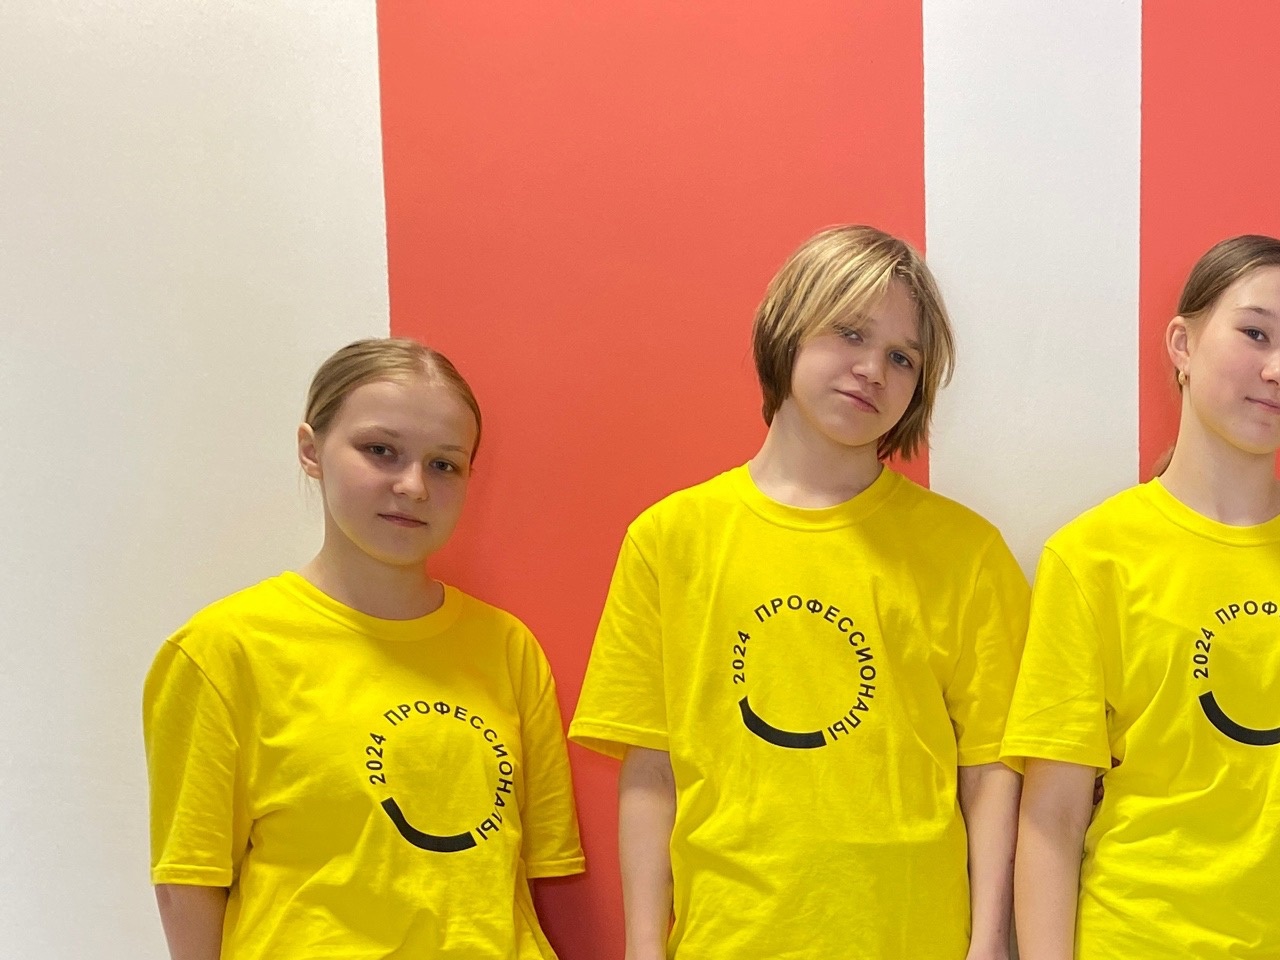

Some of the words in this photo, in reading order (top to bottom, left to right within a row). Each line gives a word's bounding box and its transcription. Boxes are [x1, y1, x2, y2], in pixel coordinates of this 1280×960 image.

[732, 630, 751, 685] 2024
[754, 594, 877, 741] ПРОФЕССИОНАЛЫ
[1193, 627, 1215, 679] 2024
[365, 732, 387, 785] 2024
[383, 700, 514, 841] ПРОФЕССИОНАЛЫ
